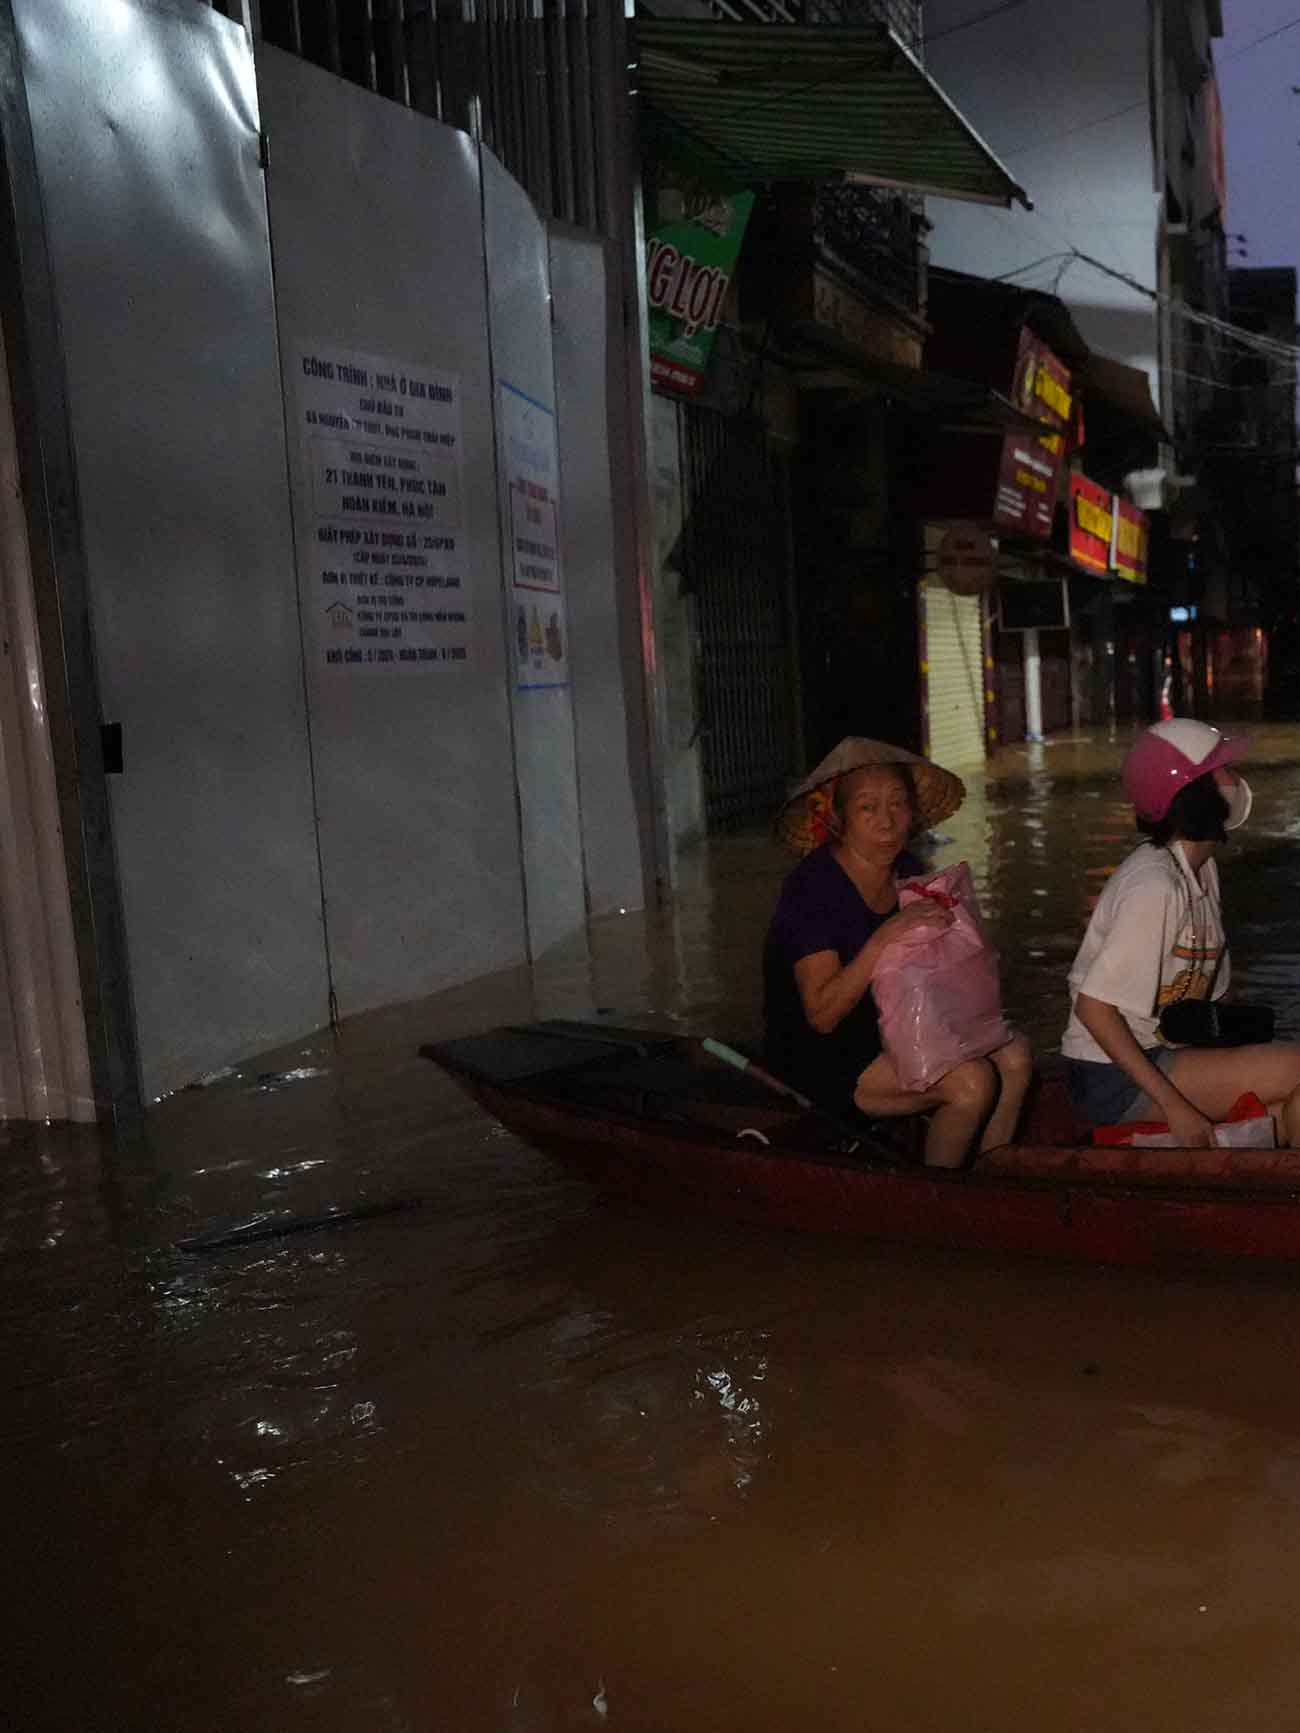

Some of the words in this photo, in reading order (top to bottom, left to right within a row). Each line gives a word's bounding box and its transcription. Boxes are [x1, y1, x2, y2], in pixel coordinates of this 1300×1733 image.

[303, 355, 335, 380] CÔNG
[336, 360, 368, 388] TRÌNH
[326, 468, 338, 485] 21
